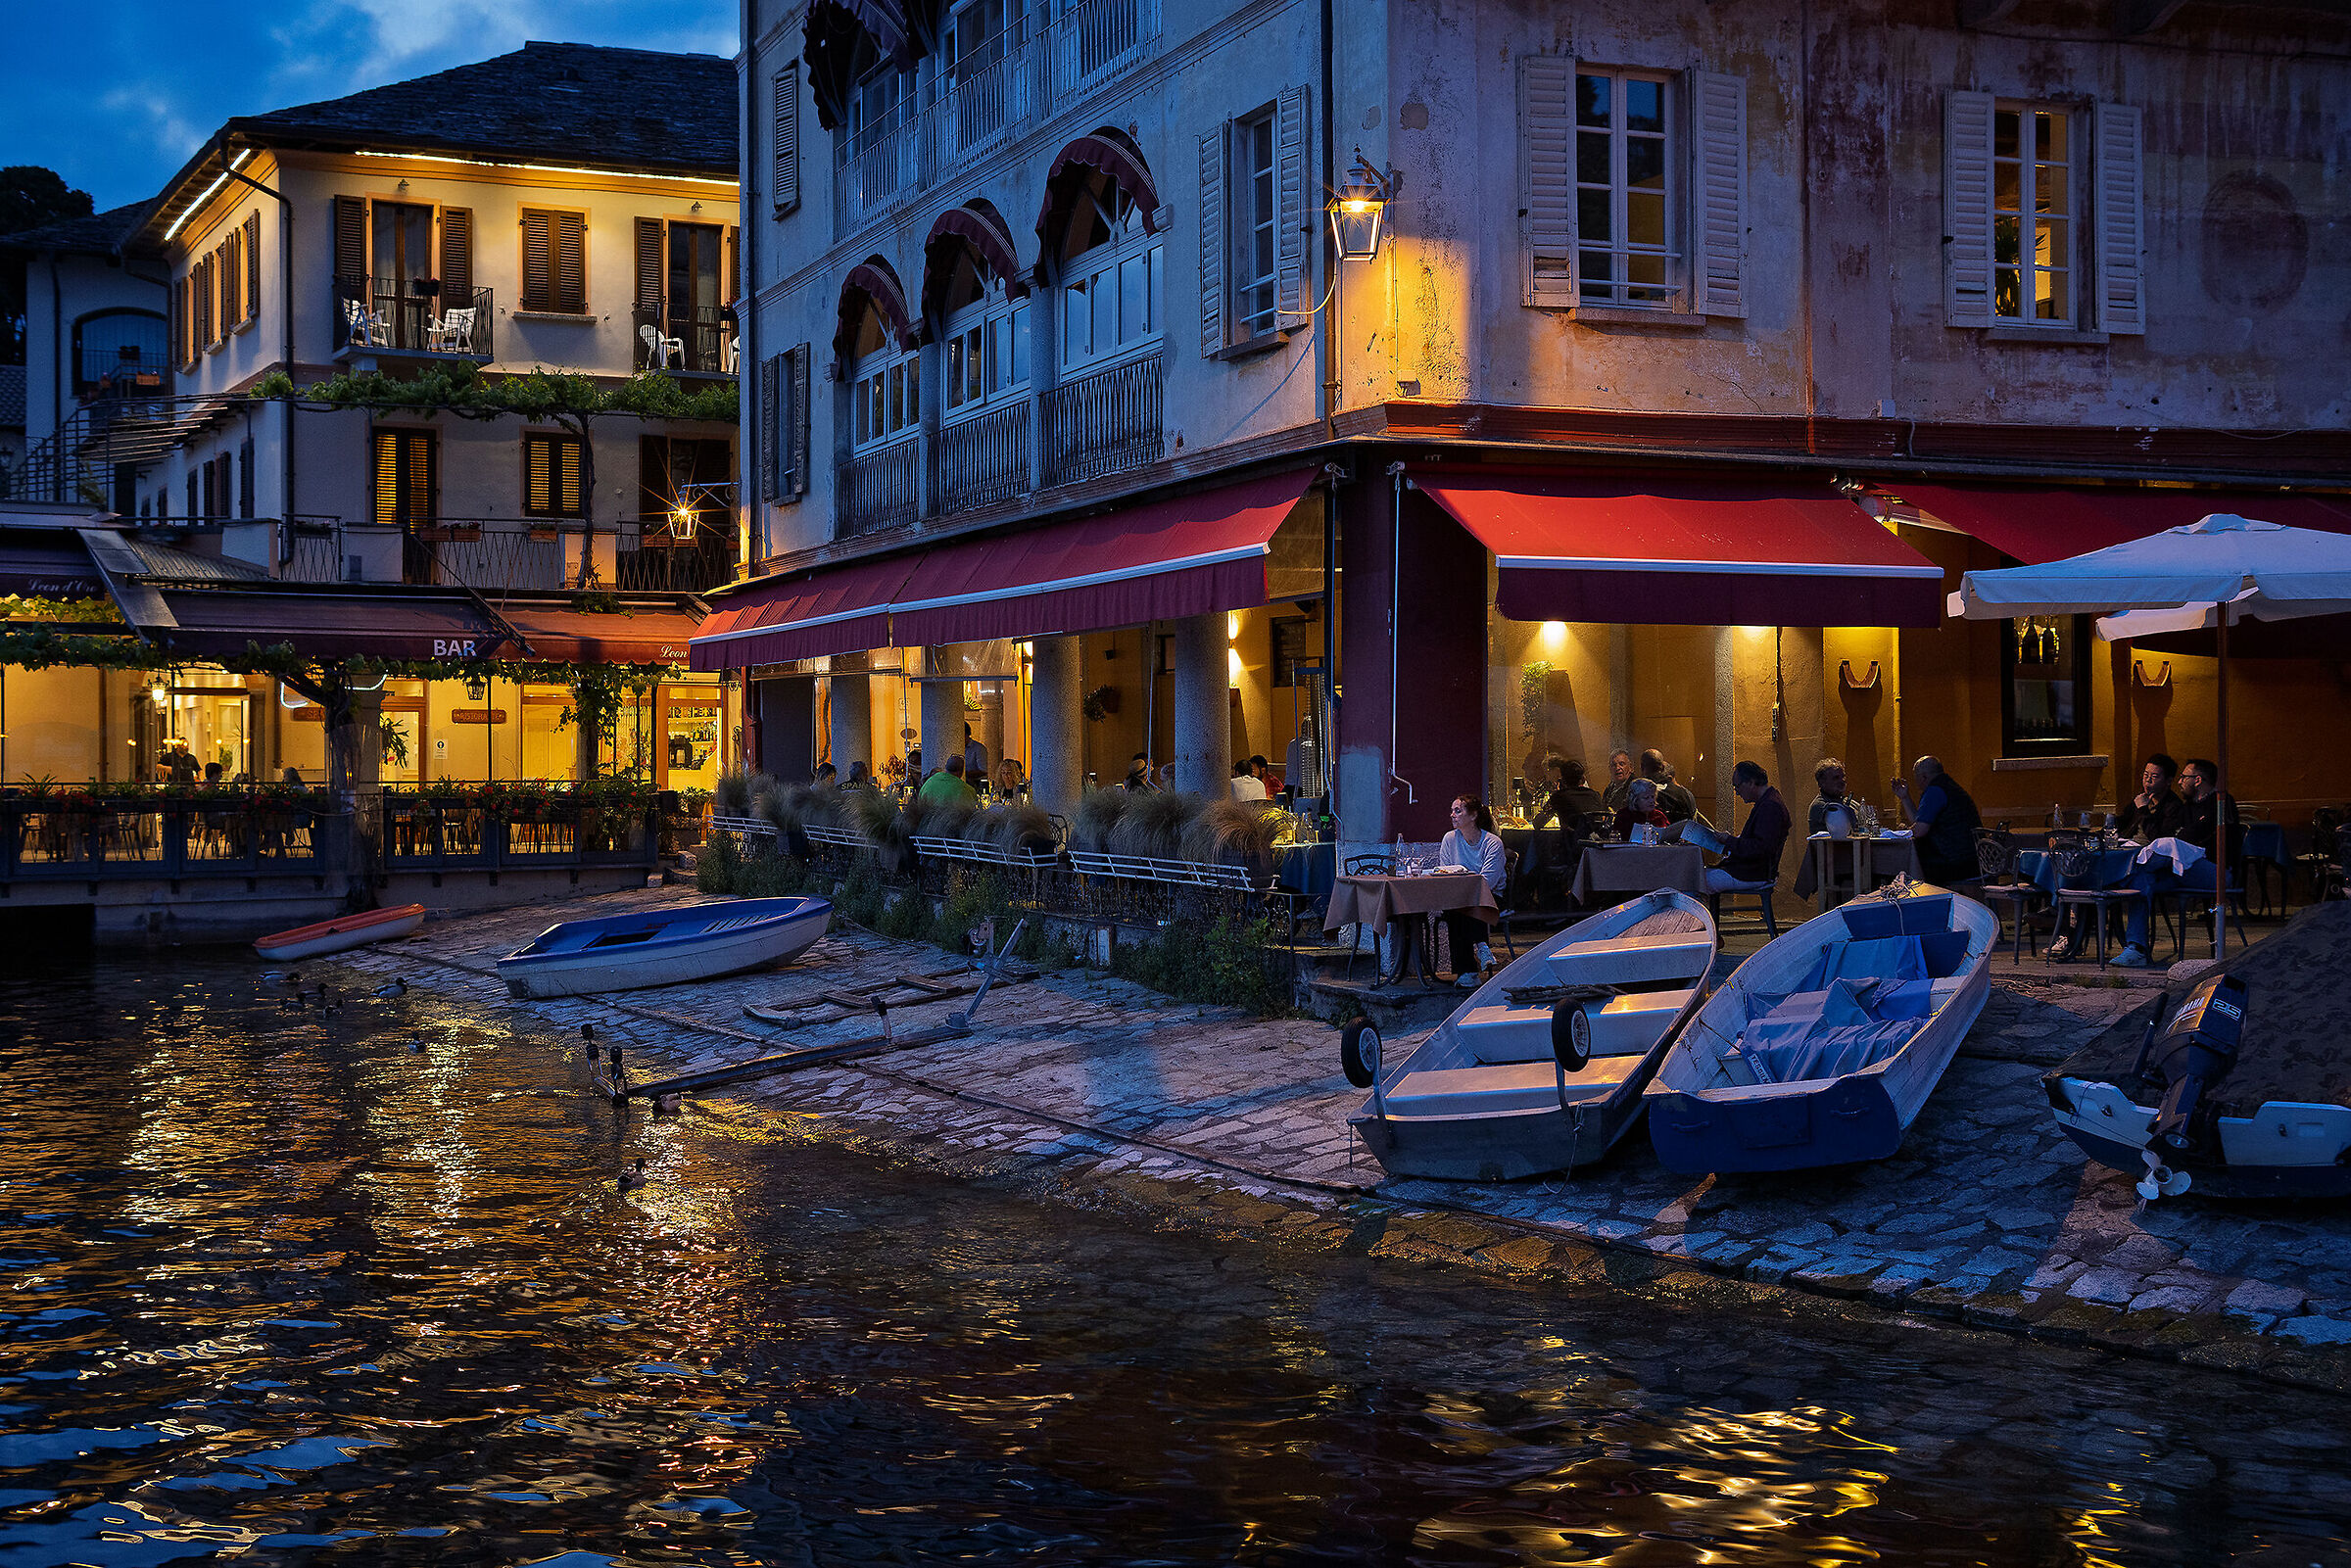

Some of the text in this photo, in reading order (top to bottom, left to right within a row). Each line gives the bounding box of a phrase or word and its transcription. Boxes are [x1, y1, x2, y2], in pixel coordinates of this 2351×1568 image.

[433, 639, 477, 657] BAR
[659, 644, 689, 658] Leon
[2213, 998, 2242, 1020] 25
